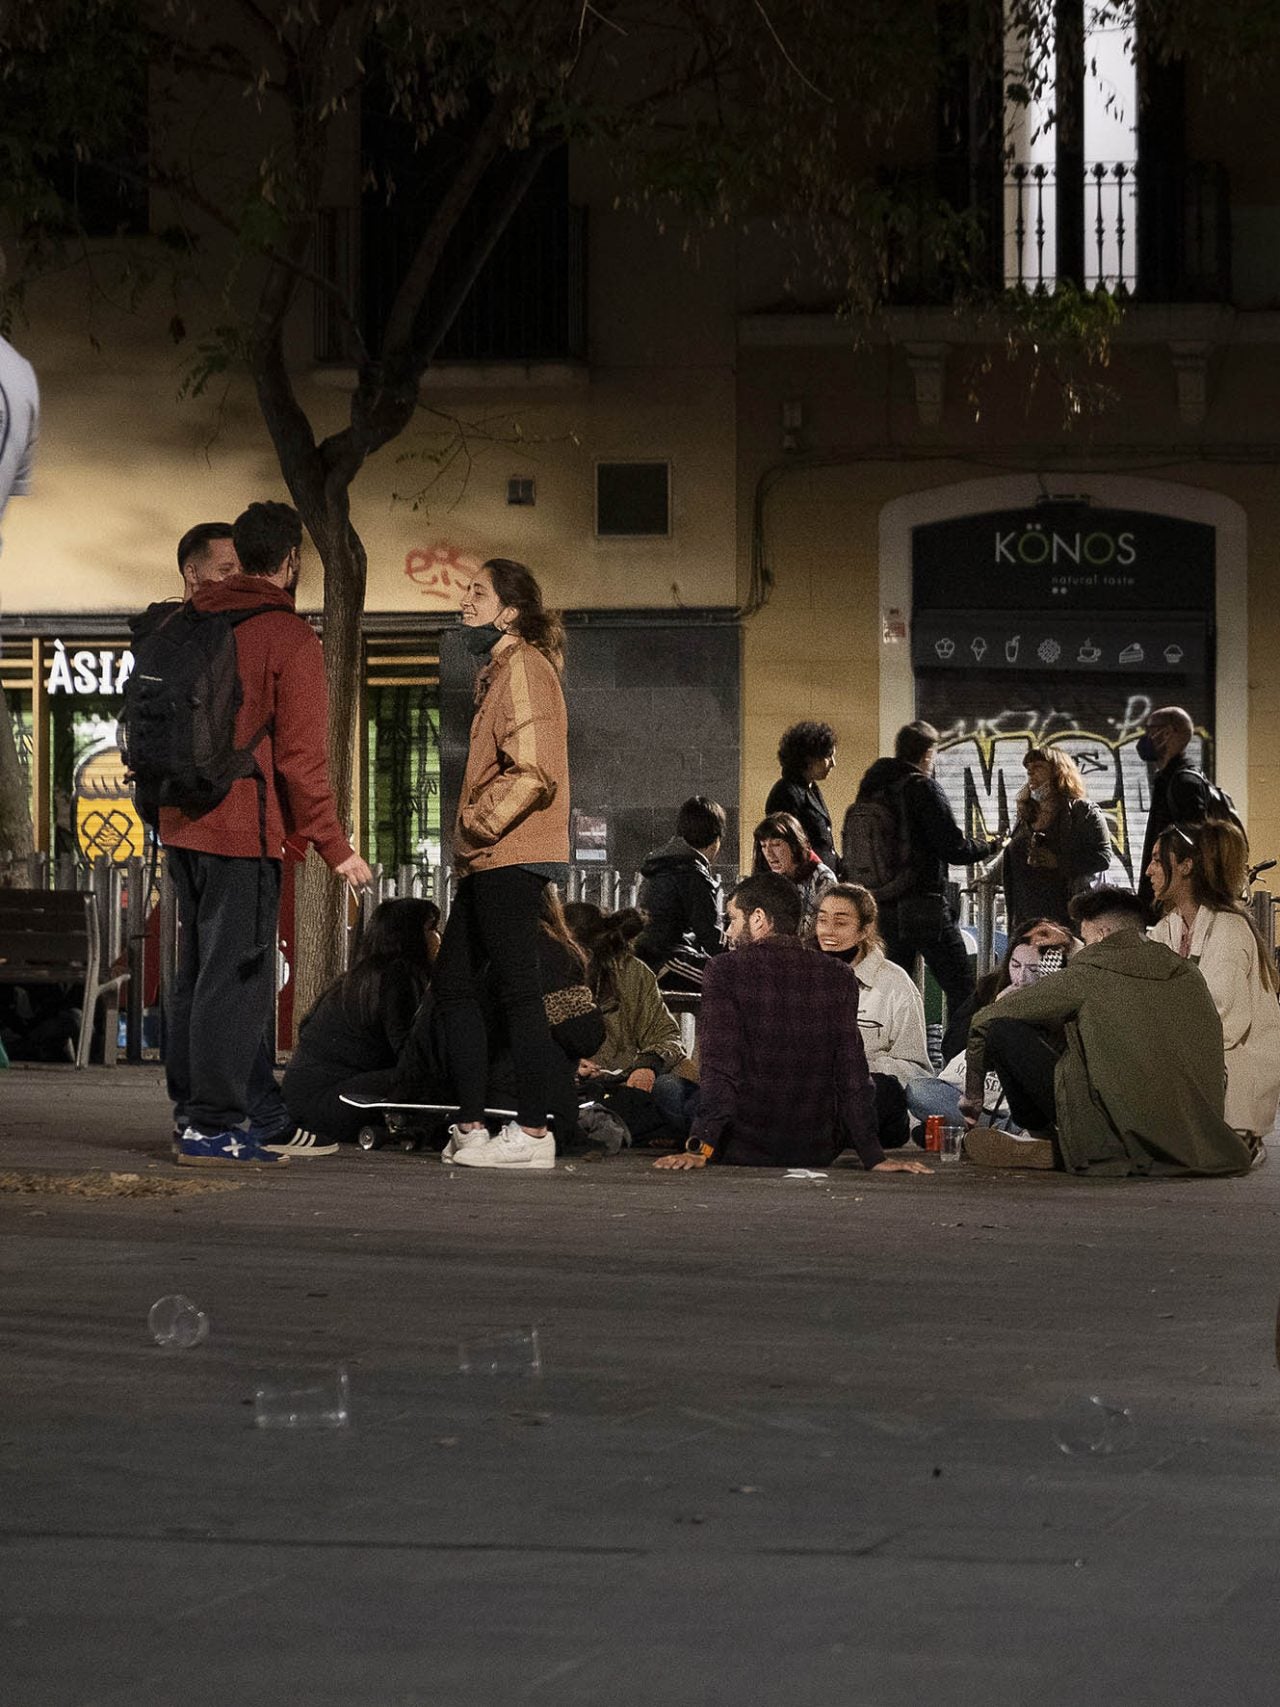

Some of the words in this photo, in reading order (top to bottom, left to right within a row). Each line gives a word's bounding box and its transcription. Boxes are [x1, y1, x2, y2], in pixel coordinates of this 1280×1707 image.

[994, 523, 1136, 565] KÖNOS
[1050, 574, 1097, 585] natural
[1103, 575, 1135, 585] taste
